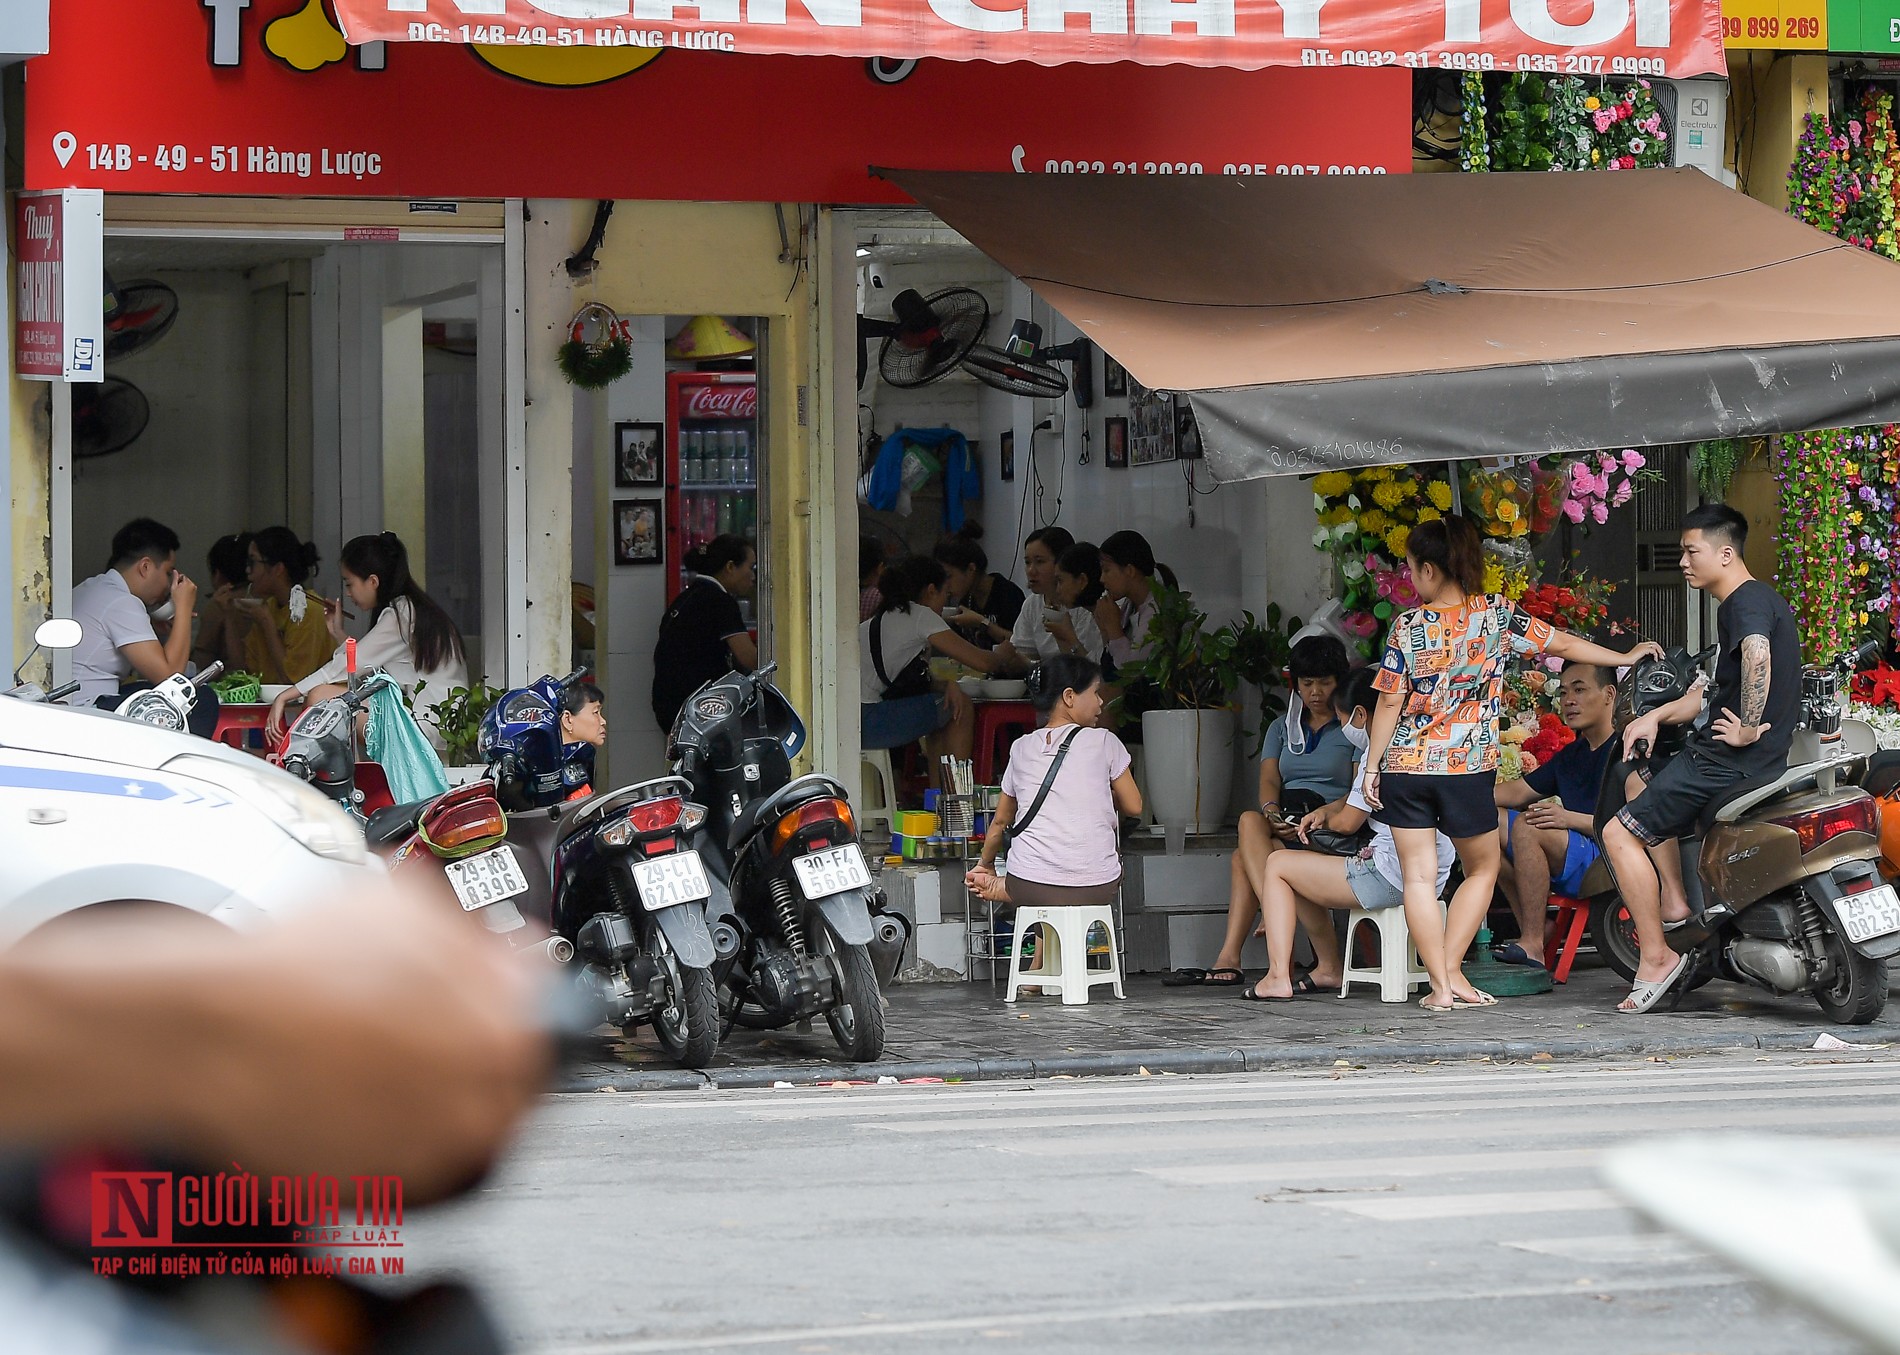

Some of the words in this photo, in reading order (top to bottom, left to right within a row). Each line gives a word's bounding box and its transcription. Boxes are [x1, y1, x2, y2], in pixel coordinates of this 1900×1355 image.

[408, 23, 450, 41] ĐC:
[459, 24, 585, 45] 14B-49-51
[595, 24, 664, 47] HÀNG
[1747, 16, 1779, 38] 899
[1786, 17, 1819, 38] 269
[1301, 48, 1334, 66] ĐT:
[1341, 50, 1397, 66] 0932
[1403, 51, 1430, 68] 31
[1438, 52, 1495, 70] 3939
[1517, 54, 1558, 71] 035
[1565, 55, 1606, 73] 207
[1612, 57, 1665, 76] 9999
[1680, 120, 1718, 129] Electrolux
[86, 144, 132, 170] 14B
[154, 144, 187, 171] 49
[210, 146, 238, 172] 51
[247, 145, 311, 177] Hàng
[321, 148, 382, 180] Lược
[643, 856, 693, 884] 29-C1
[804, 849, 854, 875] 30-F4
[466, 872, 517, 904] 8396
[644, 876, 706, 906] 621.68
[811, 866, 862, 894] 5660
[1843, 890, 1890, 918] 29-C1
[1848, 908, 1900, 938] 082.52
[1641, 989, 1655, 1005] NIKE
